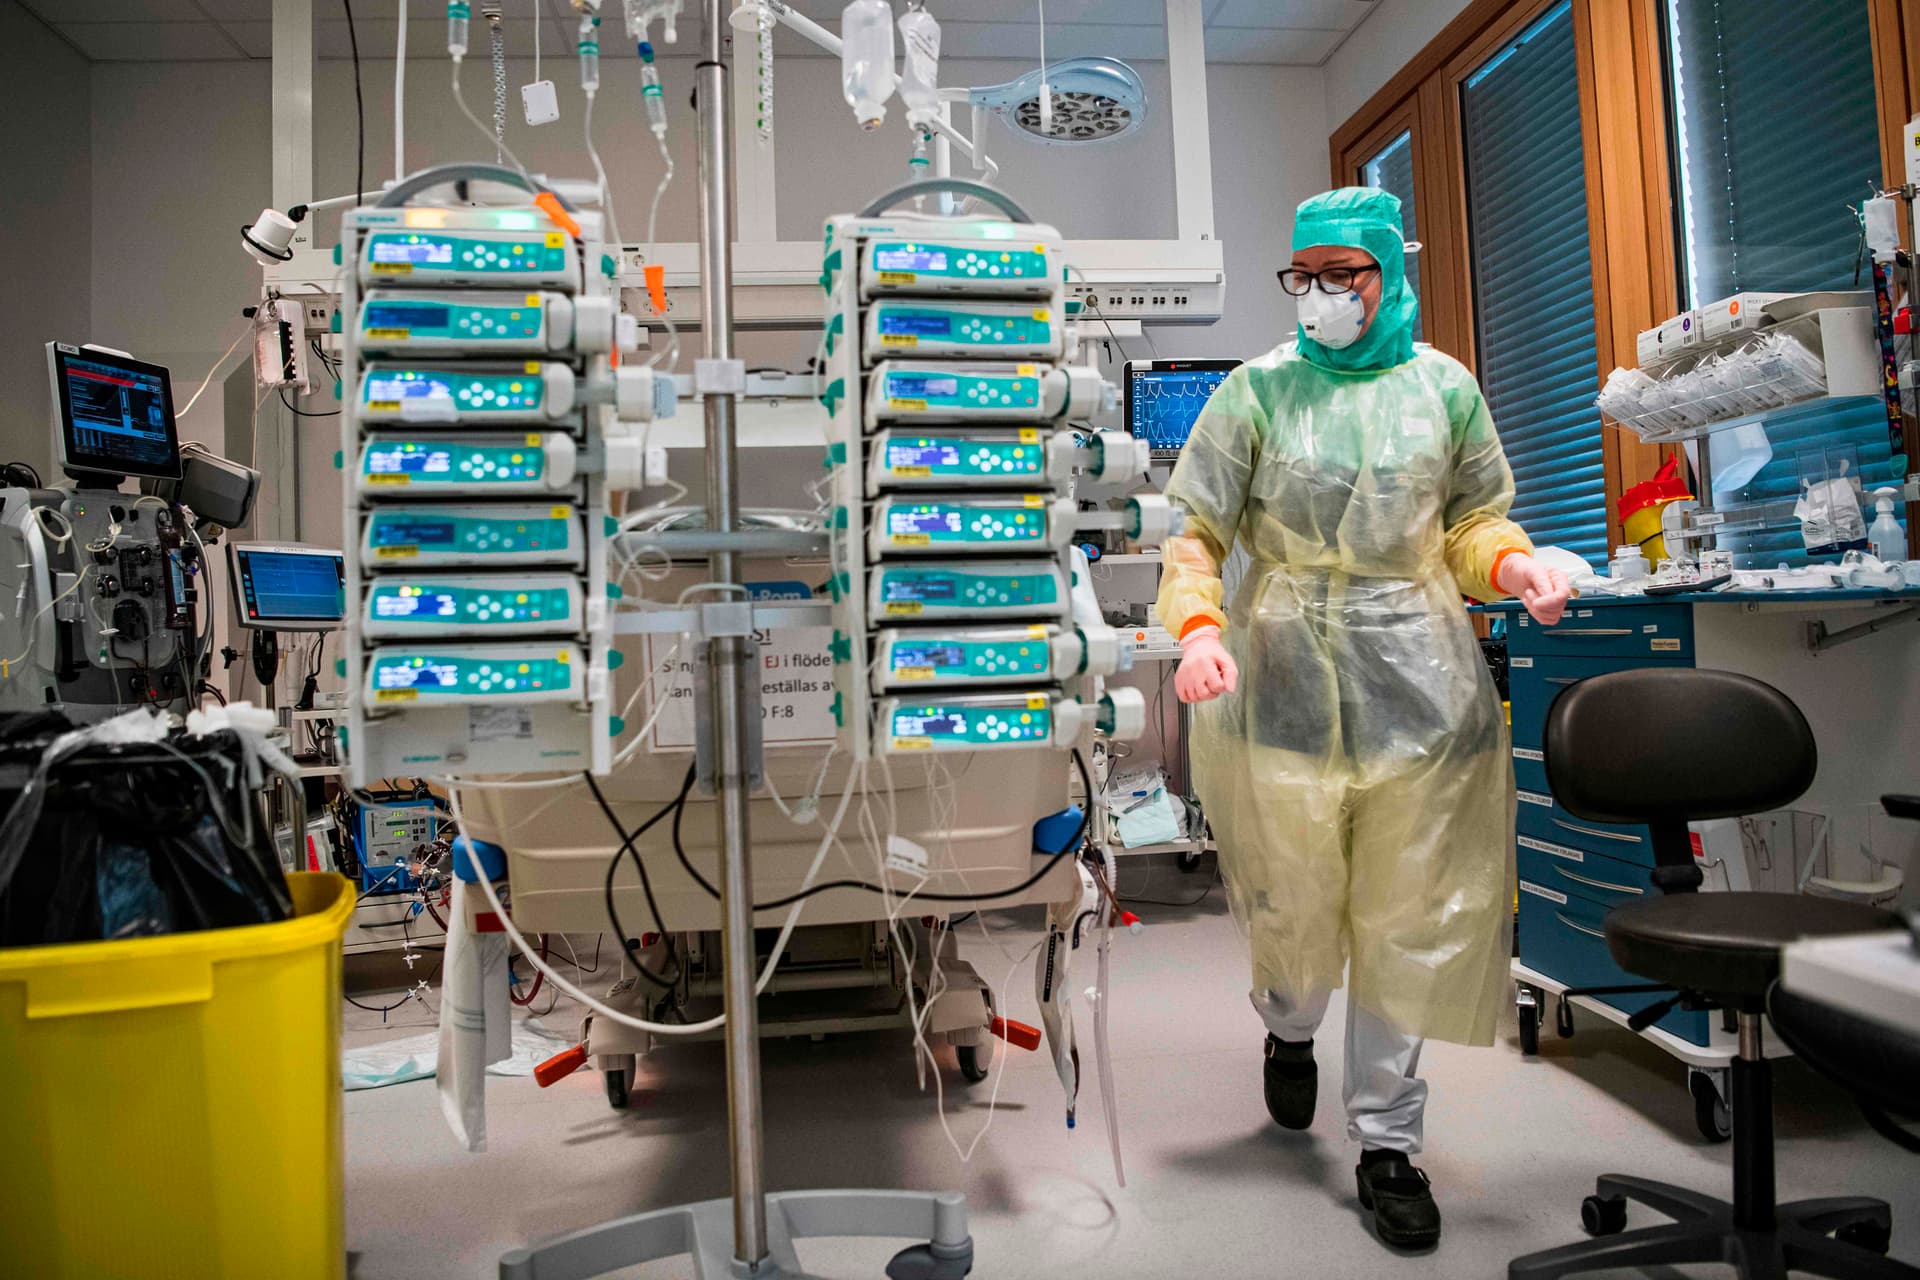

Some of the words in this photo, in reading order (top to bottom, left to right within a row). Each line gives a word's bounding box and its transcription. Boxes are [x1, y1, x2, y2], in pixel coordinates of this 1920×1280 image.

[764, 655, 779, 668] EJ
[784, 654, 788, 667] i
[793, 653, 833, 667] flöde
[762, 680, 818, 694] eställas
[772, 705, 794, 718] F:8
